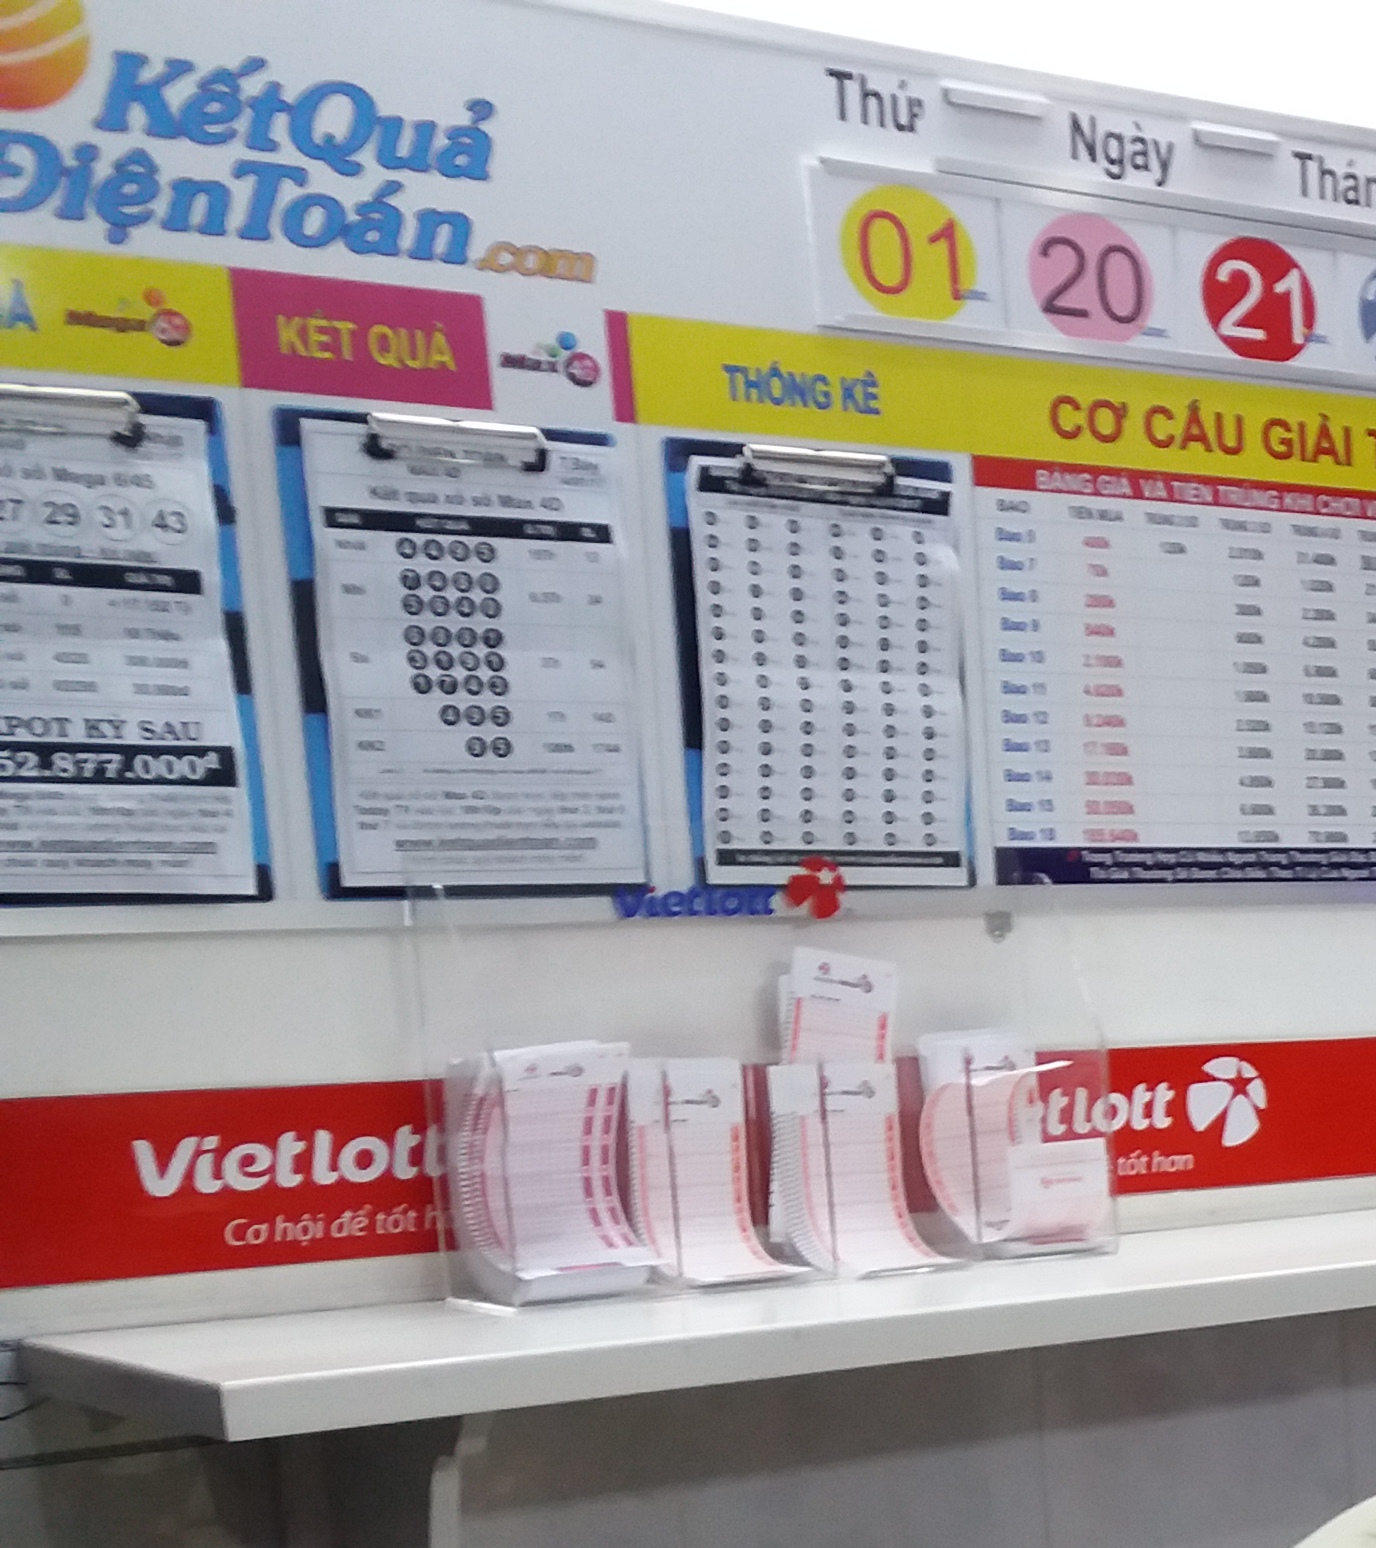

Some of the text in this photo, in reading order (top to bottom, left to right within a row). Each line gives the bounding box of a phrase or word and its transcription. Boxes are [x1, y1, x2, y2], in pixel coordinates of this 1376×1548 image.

[95, 50, 497, 181] KếtQuả
[824, 66, 924, 134] Thứ
[1069, 111, 1174, 187] Ngày
[858, 209, 962, 301] 01
[1038, 235, 1146, 324] 20
[1215, 258, 1306, 345] 21
[840, 369, 882, 416] KÊ
[1048, 394, 1129, 443] CƠ
[1143, 398, 1245, 456] CẤU
[1260, 411, 1353, 467] GIẢI
[44, 499, 82, 527] 29
[98, 503, 136, 531] 31
[151, 508, 189, 536] 43
[0, 716, 72, 738] POT
[137, 720, 204, 741] SAU
[1046, 1081, 1175, 1136] tlott
[223, 1218, 269, 1246] Cơ
[274, 1213, 325, 1246] hội
[375, 1203, 418, 1234] tốt
